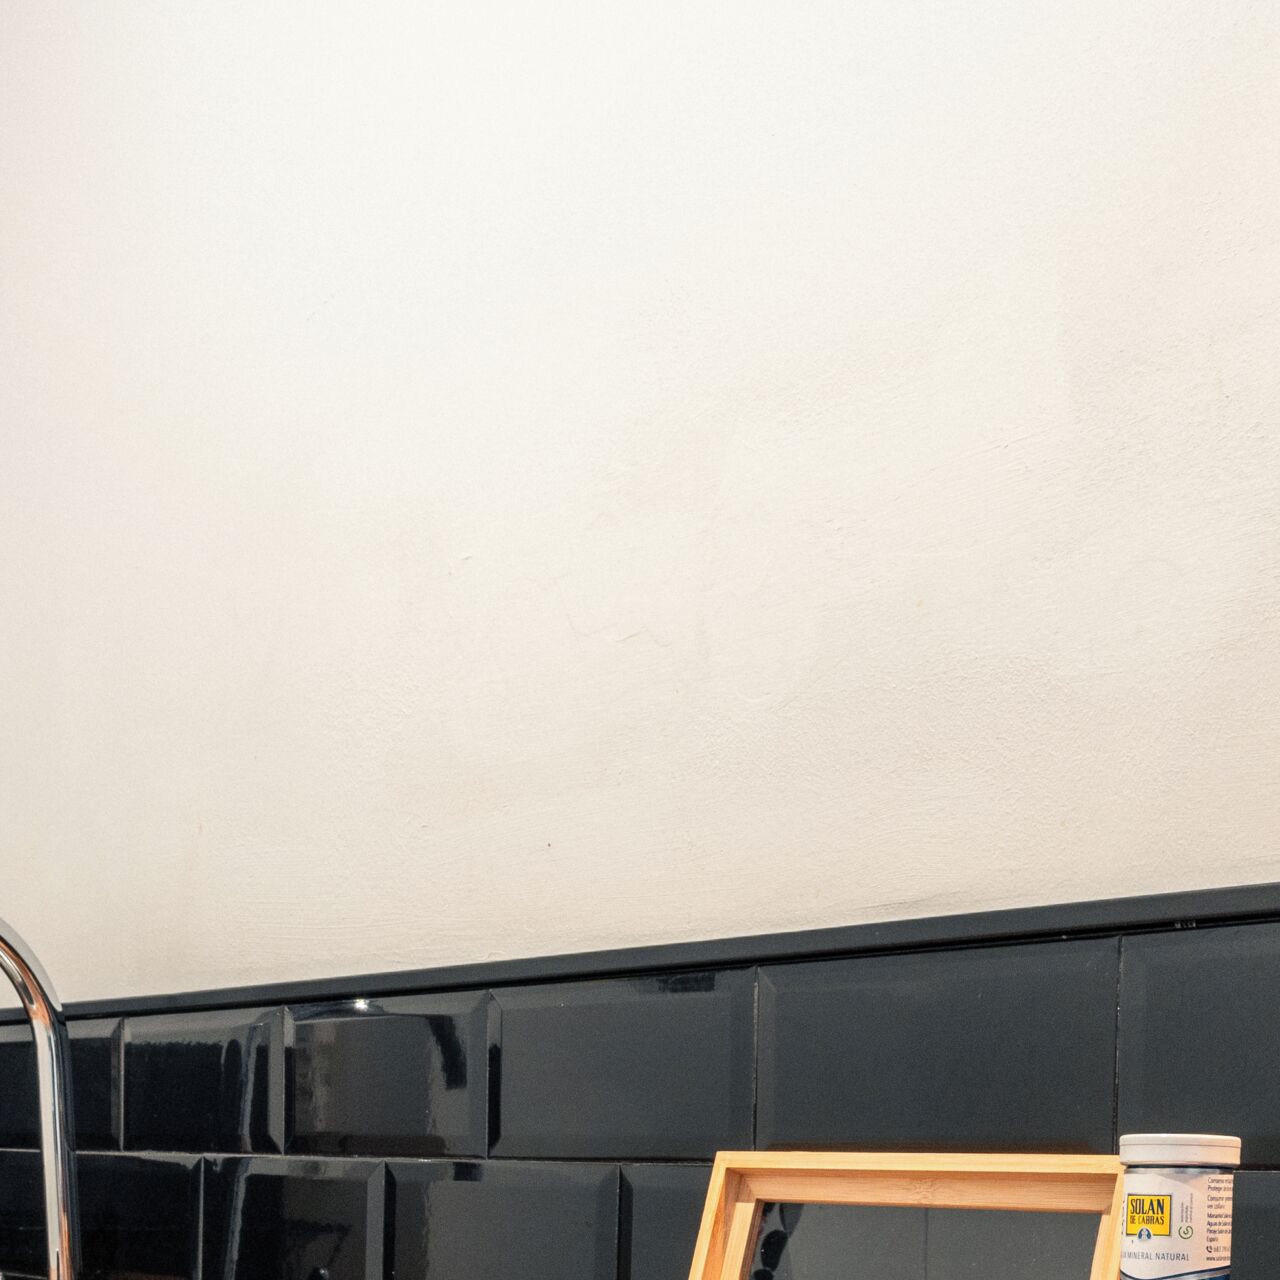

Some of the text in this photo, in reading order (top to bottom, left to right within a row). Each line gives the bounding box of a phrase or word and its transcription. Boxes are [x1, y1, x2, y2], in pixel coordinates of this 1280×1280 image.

[1130, 1198, 1165, 1215] SOLAN
[1129, 1215, 1165, 1225] DE CABRAS
[1126, 1251, 1153, 1260] MINERAL
[1155, 1252, 1190, 1261] NATURAL
